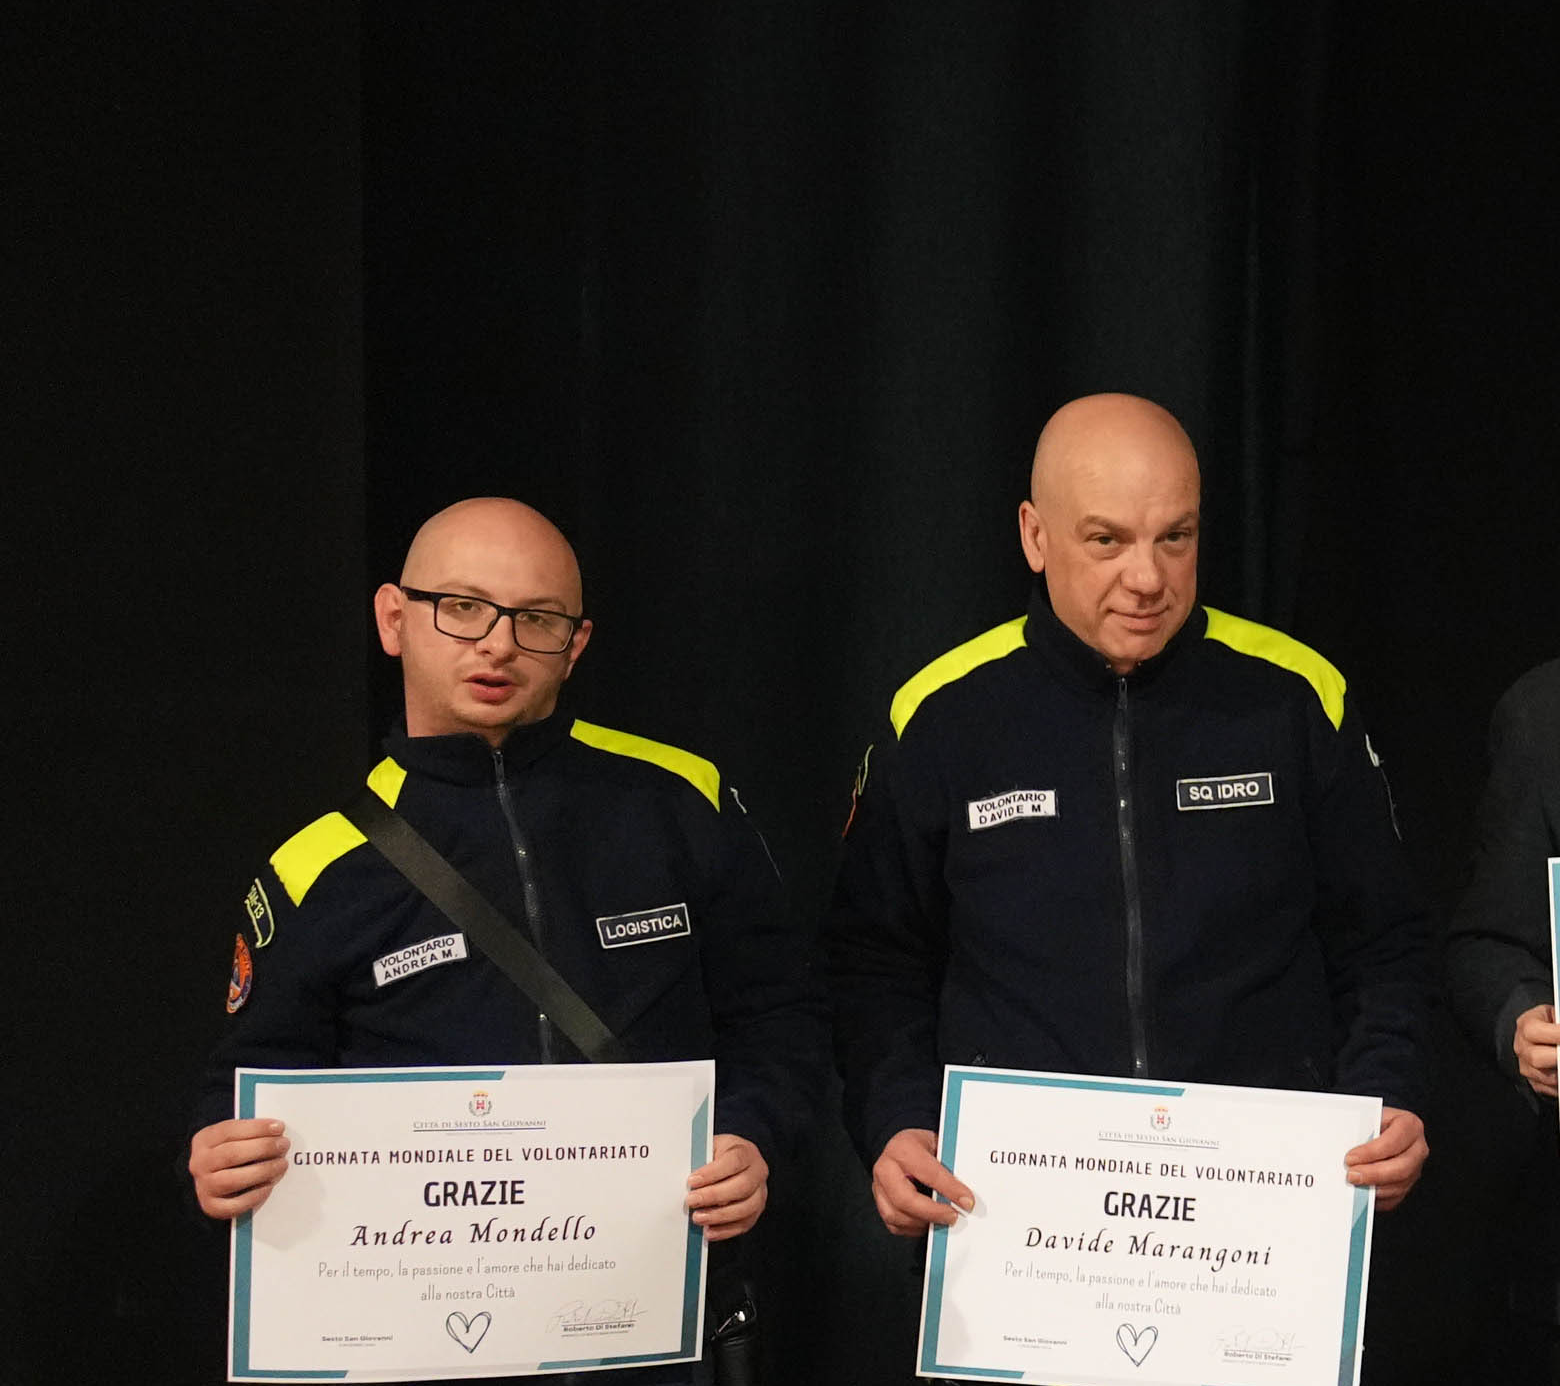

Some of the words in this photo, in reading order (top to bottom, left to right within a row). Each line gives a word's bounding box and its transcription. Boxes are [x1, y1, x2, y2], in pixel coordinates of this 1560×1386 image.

[977, 793, 1047, 813] VOLONTARIO
[1189, 785, 1214, 801] SQ
[1217, 781, 1260, 800] IDRO
[979, 804, 1025, 825] DAVIDE
[606, 914, 683, 940] LOGISTICA
[380, 937, 455, 968] VOLONTARIO
[383, 953, 439, 981] ANDREA
[293, 1150, 381, 1166] GIORNATA
[389, 1148, 475, 1164] MONDIALE
[483, 1148, 513, 1163] DEL
[521, 1144, 650, 1161] VOLONTARIATO
[989, 1150, 1067, 1169] GIORNATA
[1074, 1156, 1152, 1176] MONDIALE
[1159, 1163, 1187, 1179] DEL
[1195, 1166, 1314, 1188] VOLONTARIATO
[423, 1179, 525, 1208] GRAZIE
[1103, 1190, 1197, 1222] GRAZIE
[349, 1219, 453, 1246] Andrea
[469, 1214, 596, 1244] Mondello
[1025, 1227, 1114, 1254] Davide
[1128, 1231, 1272, 1273] Marangoni
[318, 1261, 340, 1278] Per
[342, 1260, 350, 1278] il
[398, 1258, 409, 1277] la
[412, 1263, 464, 1281] passione
[466, 1265, 473, 1276] e
[522, 1255, 544, 1273] che
[546, 1254, 564, 1273] hai
[567, 1253, 616, 1272] dedicato
[420, 1282, 442, 1302] alla
[445, 1289, 483, 1301] nostra
